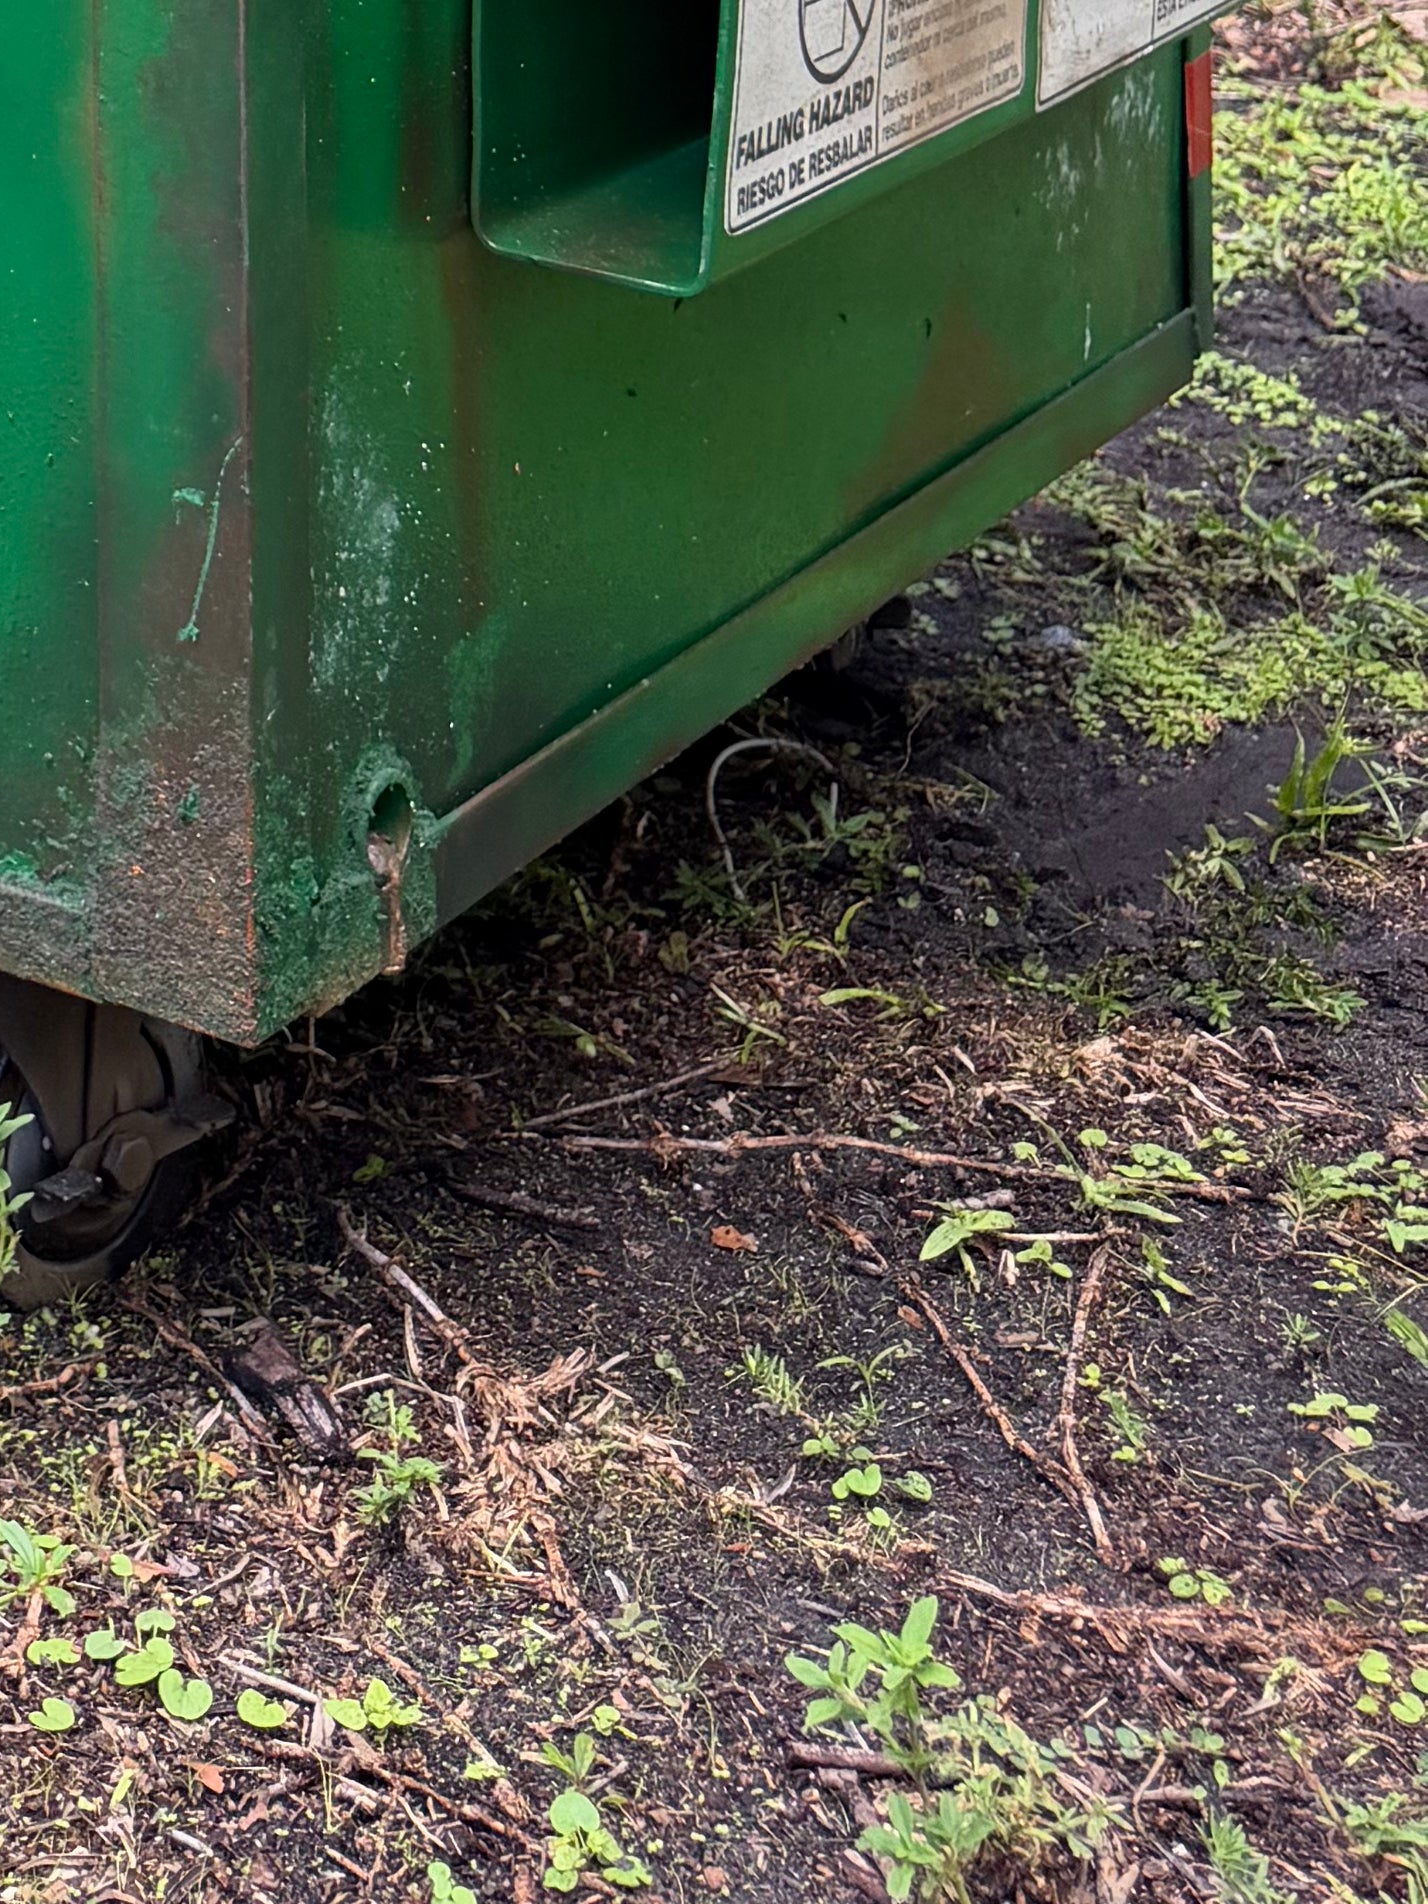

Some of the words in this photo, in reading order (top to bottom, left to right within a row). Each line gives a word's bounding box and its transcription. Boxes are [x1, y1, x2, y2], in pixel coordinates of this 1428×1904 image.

[736, 107, 805, 170] FALLING
[808, 76, 875, 135] HAZARD
[737, 167, 785, 215] RIESGO
[788, 157, 806, 190] DE
[808, 124, 873, 180] RESBALAR
